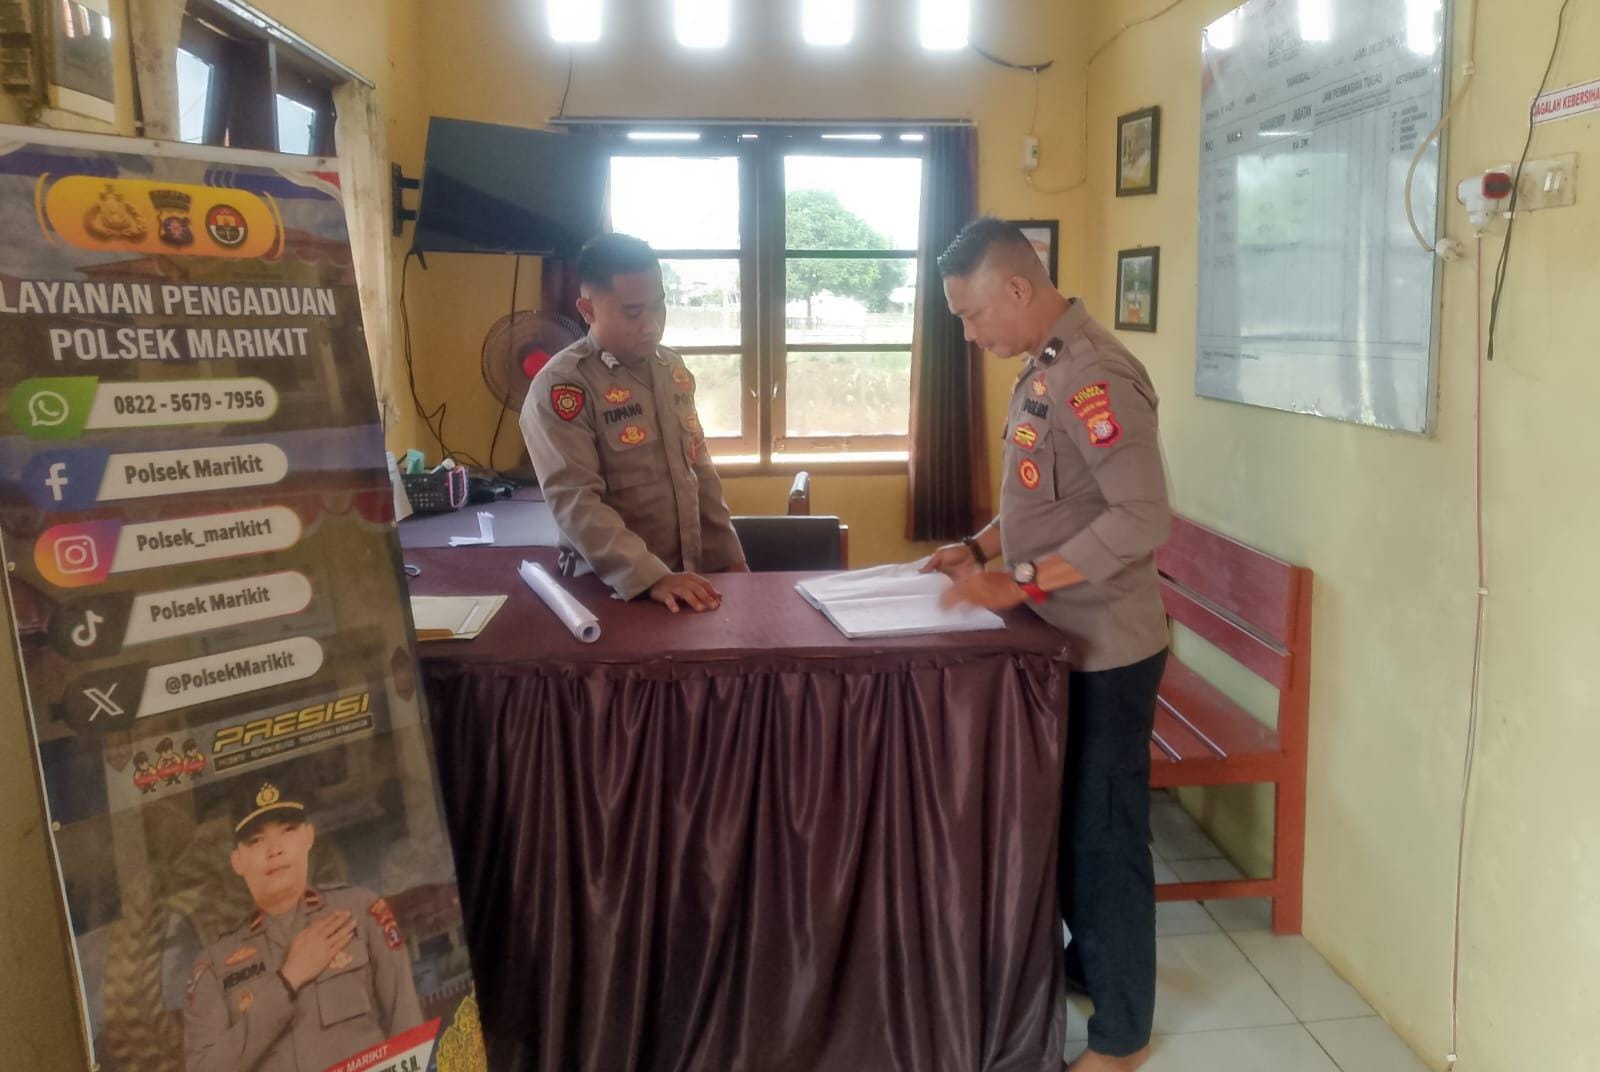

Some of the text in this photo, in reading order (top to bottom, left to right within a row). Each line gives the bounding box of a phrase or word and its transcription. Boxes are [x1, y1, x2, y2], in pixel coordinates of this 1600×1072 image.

[0, 280, 337, 316] LAYANAN PENGADUAN
[50, 328, 309, 361] POLSEK MARIKIT
[602, 403, 643, 425] TUPANG
[124, 455, 264, 485] Polsek Marikit
[136, 519, 272, 552] Polsek_marikit1
[150, 587, 270, 622] Polsek Marikit
[165, 652, 295, 695] @PolsekMarikit
[346, 1044, 389, 1072] MARIKIT
